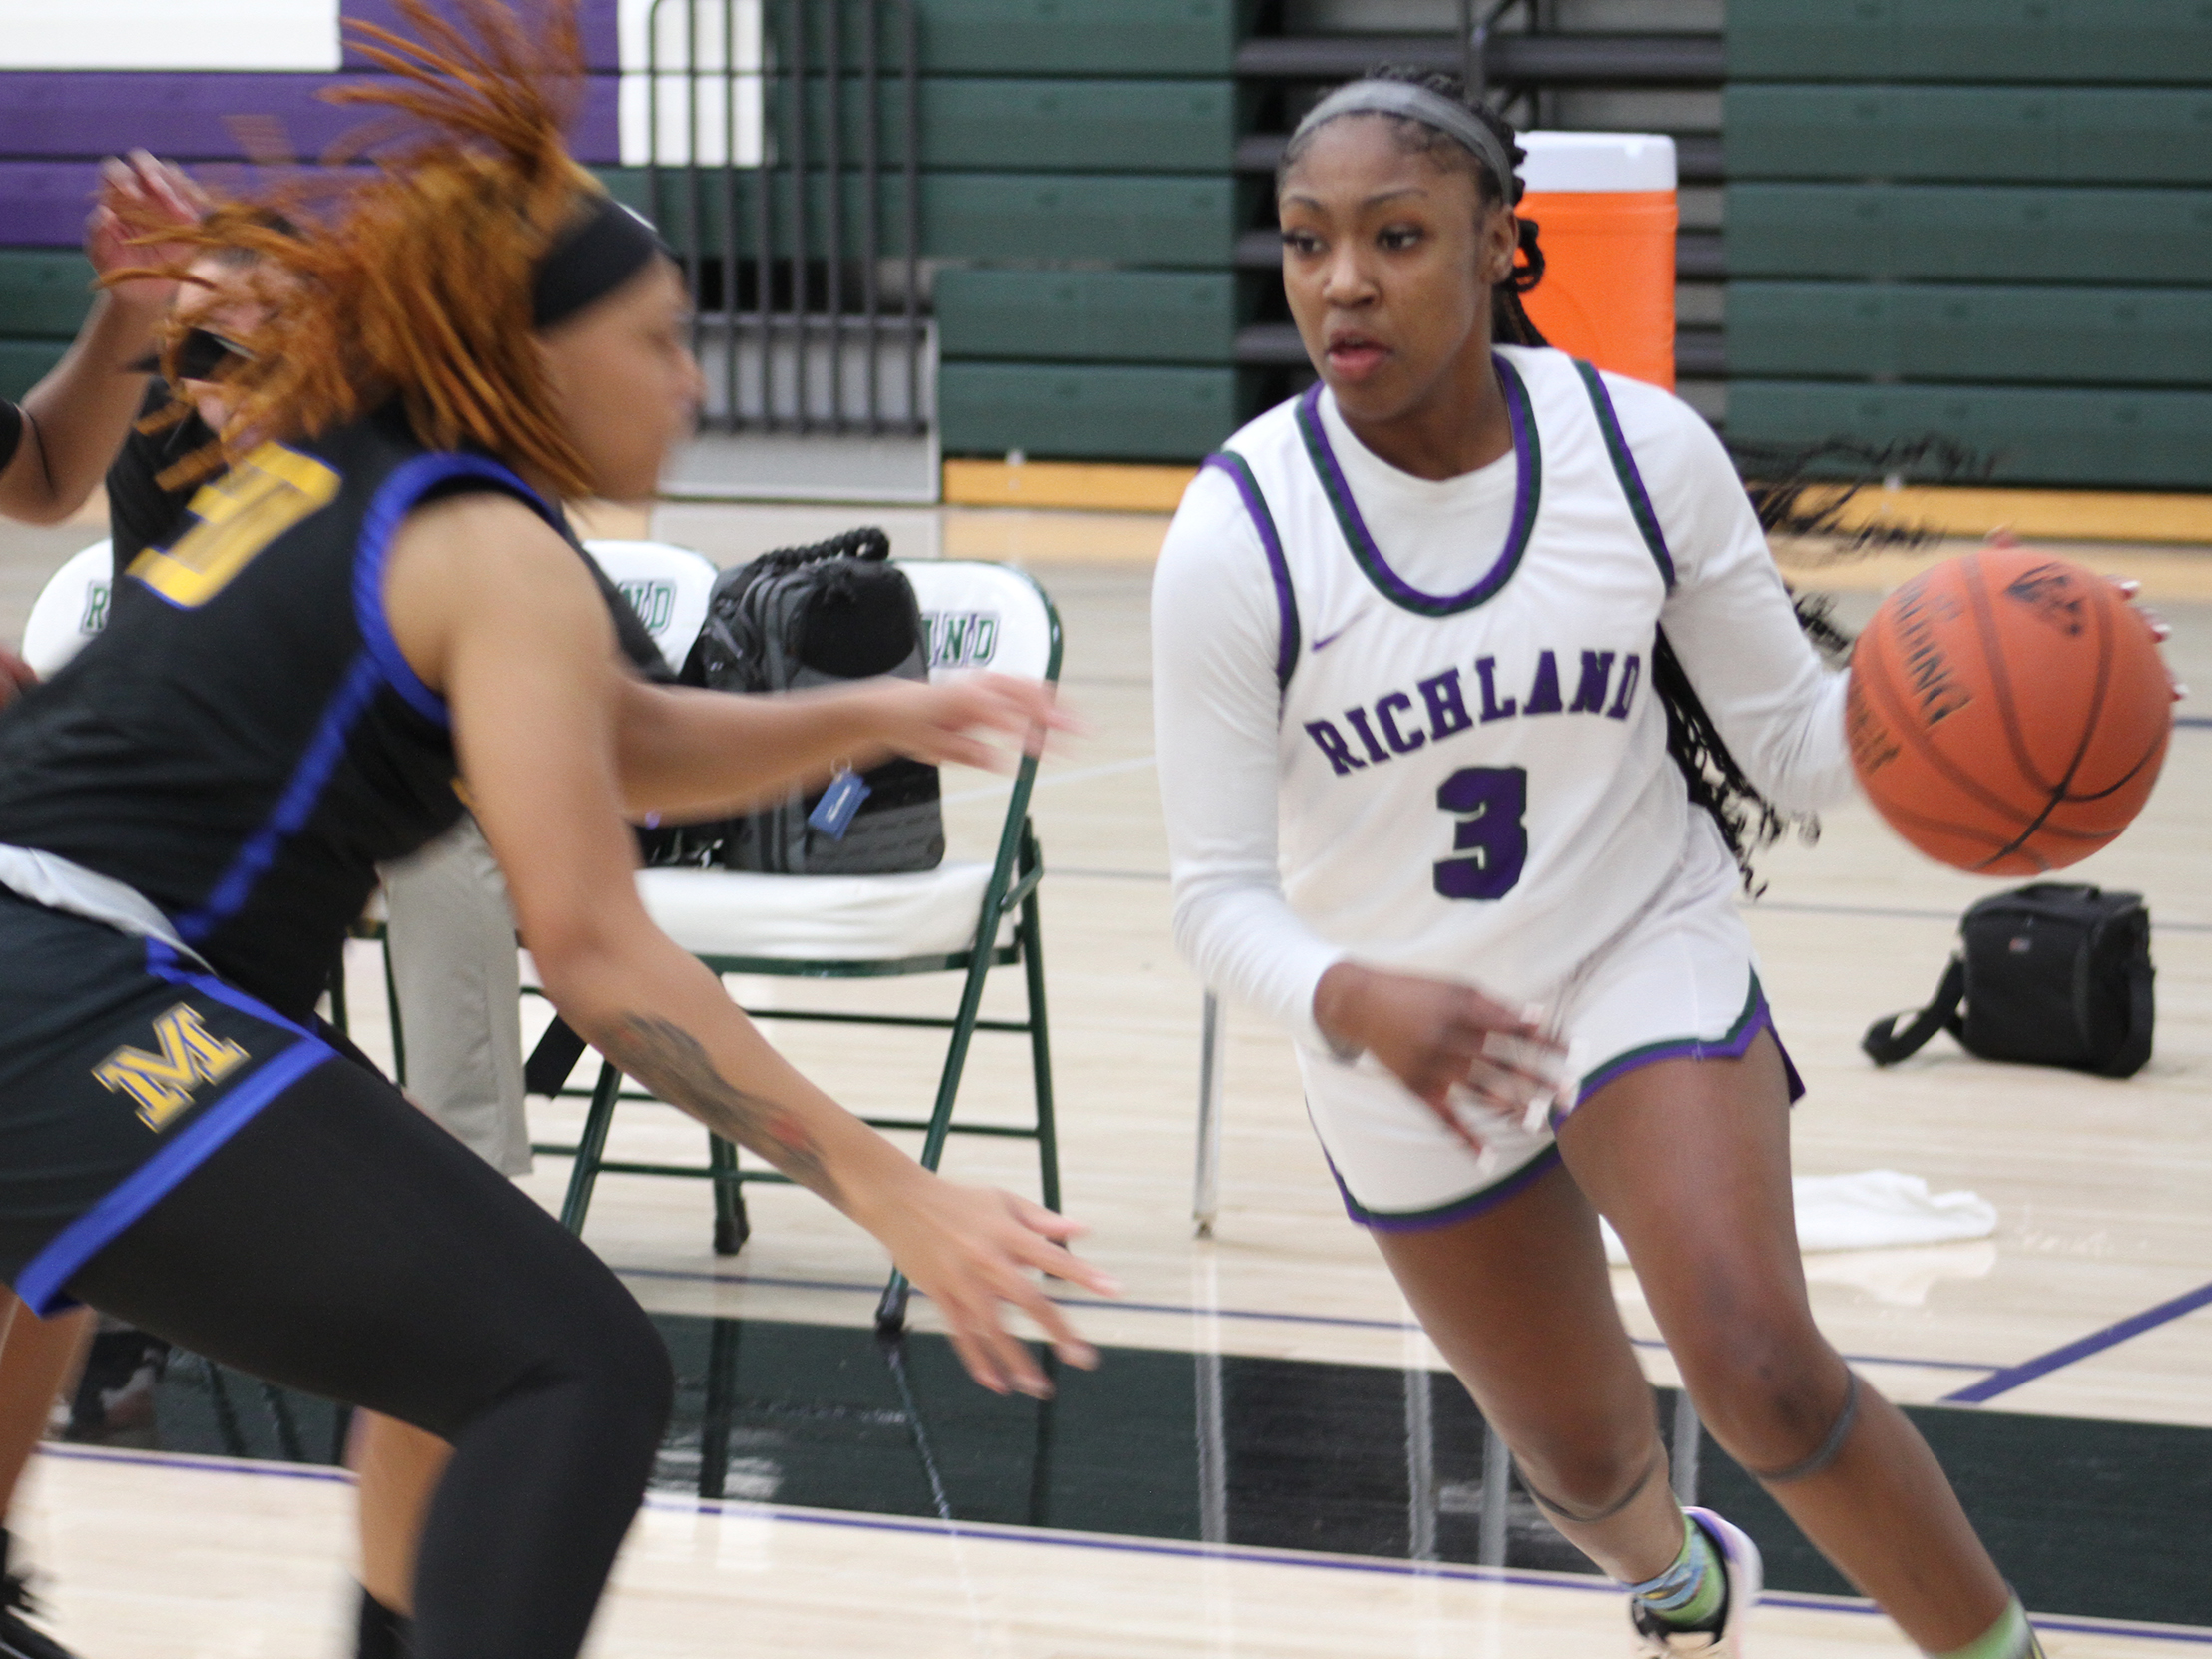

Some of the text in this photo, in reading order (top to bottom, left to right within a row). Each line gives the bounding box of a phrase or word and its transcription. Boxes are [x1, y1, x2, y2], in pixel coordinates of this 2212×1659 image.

[1303, 649, 1640, 776] RICHLAND
[1432, 765, 1528, 901] 3
[90, 1001, 252, 1134] M
